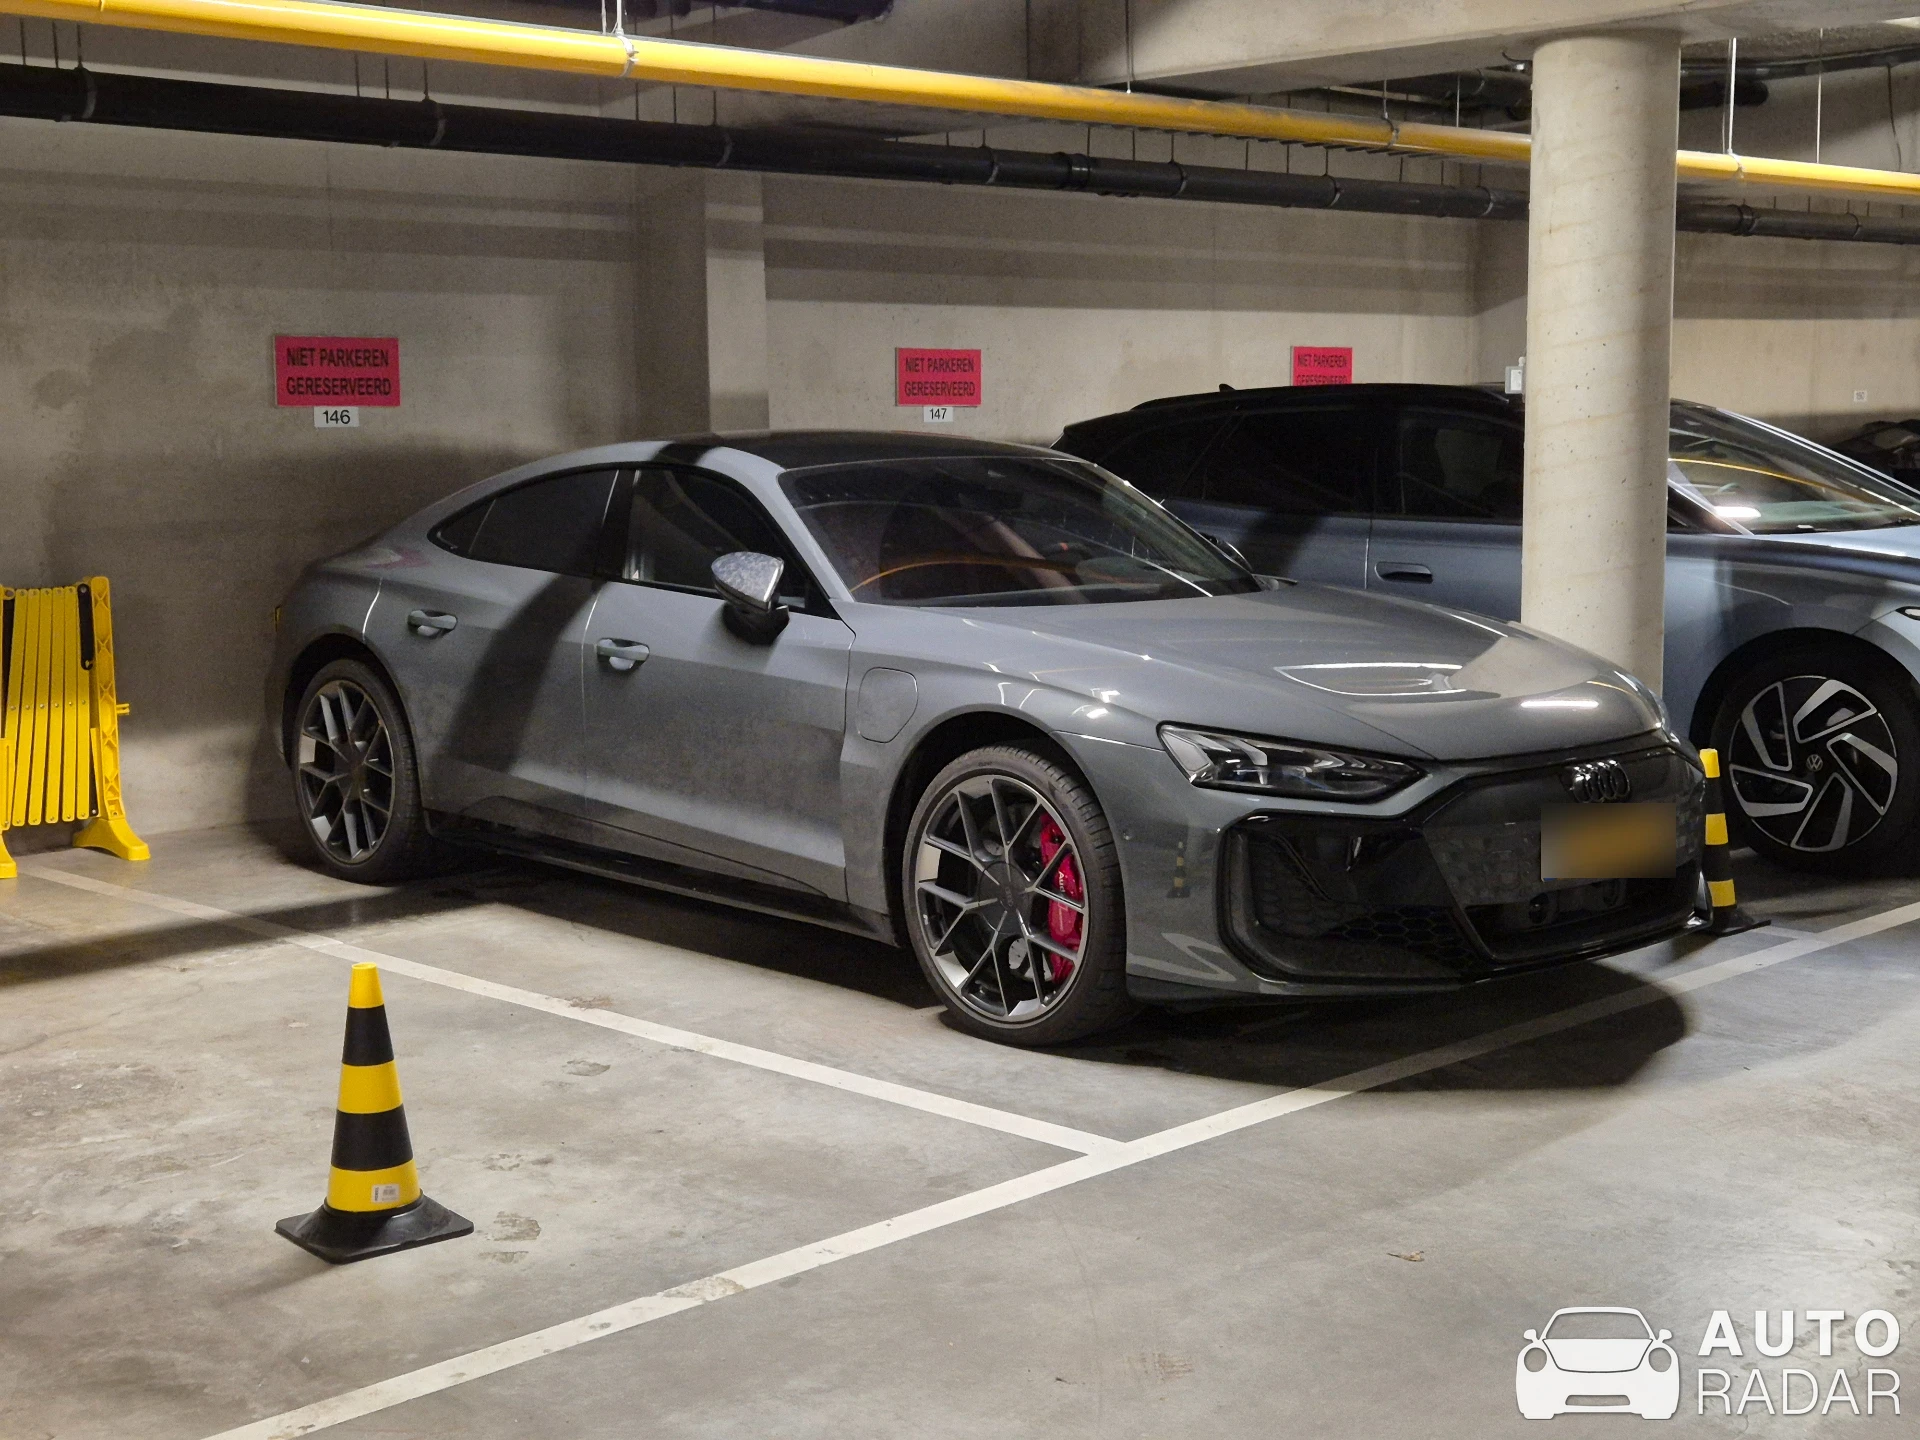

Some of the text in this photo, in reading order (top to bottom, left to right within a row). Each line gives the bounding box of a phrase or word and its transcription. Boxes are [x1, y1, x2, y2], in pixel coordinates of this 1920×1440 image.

[286, 348, 389, 367] NIET PARKEREN
[905, 357, 974, 372] NIET PARKEREN
[286, 377, 391, 395] GERESERVEERD
[904, 381, 975, 396] GERESERVEERD
[322, 409, 351, 425] 146
[929, 408, 947, 420] 147
